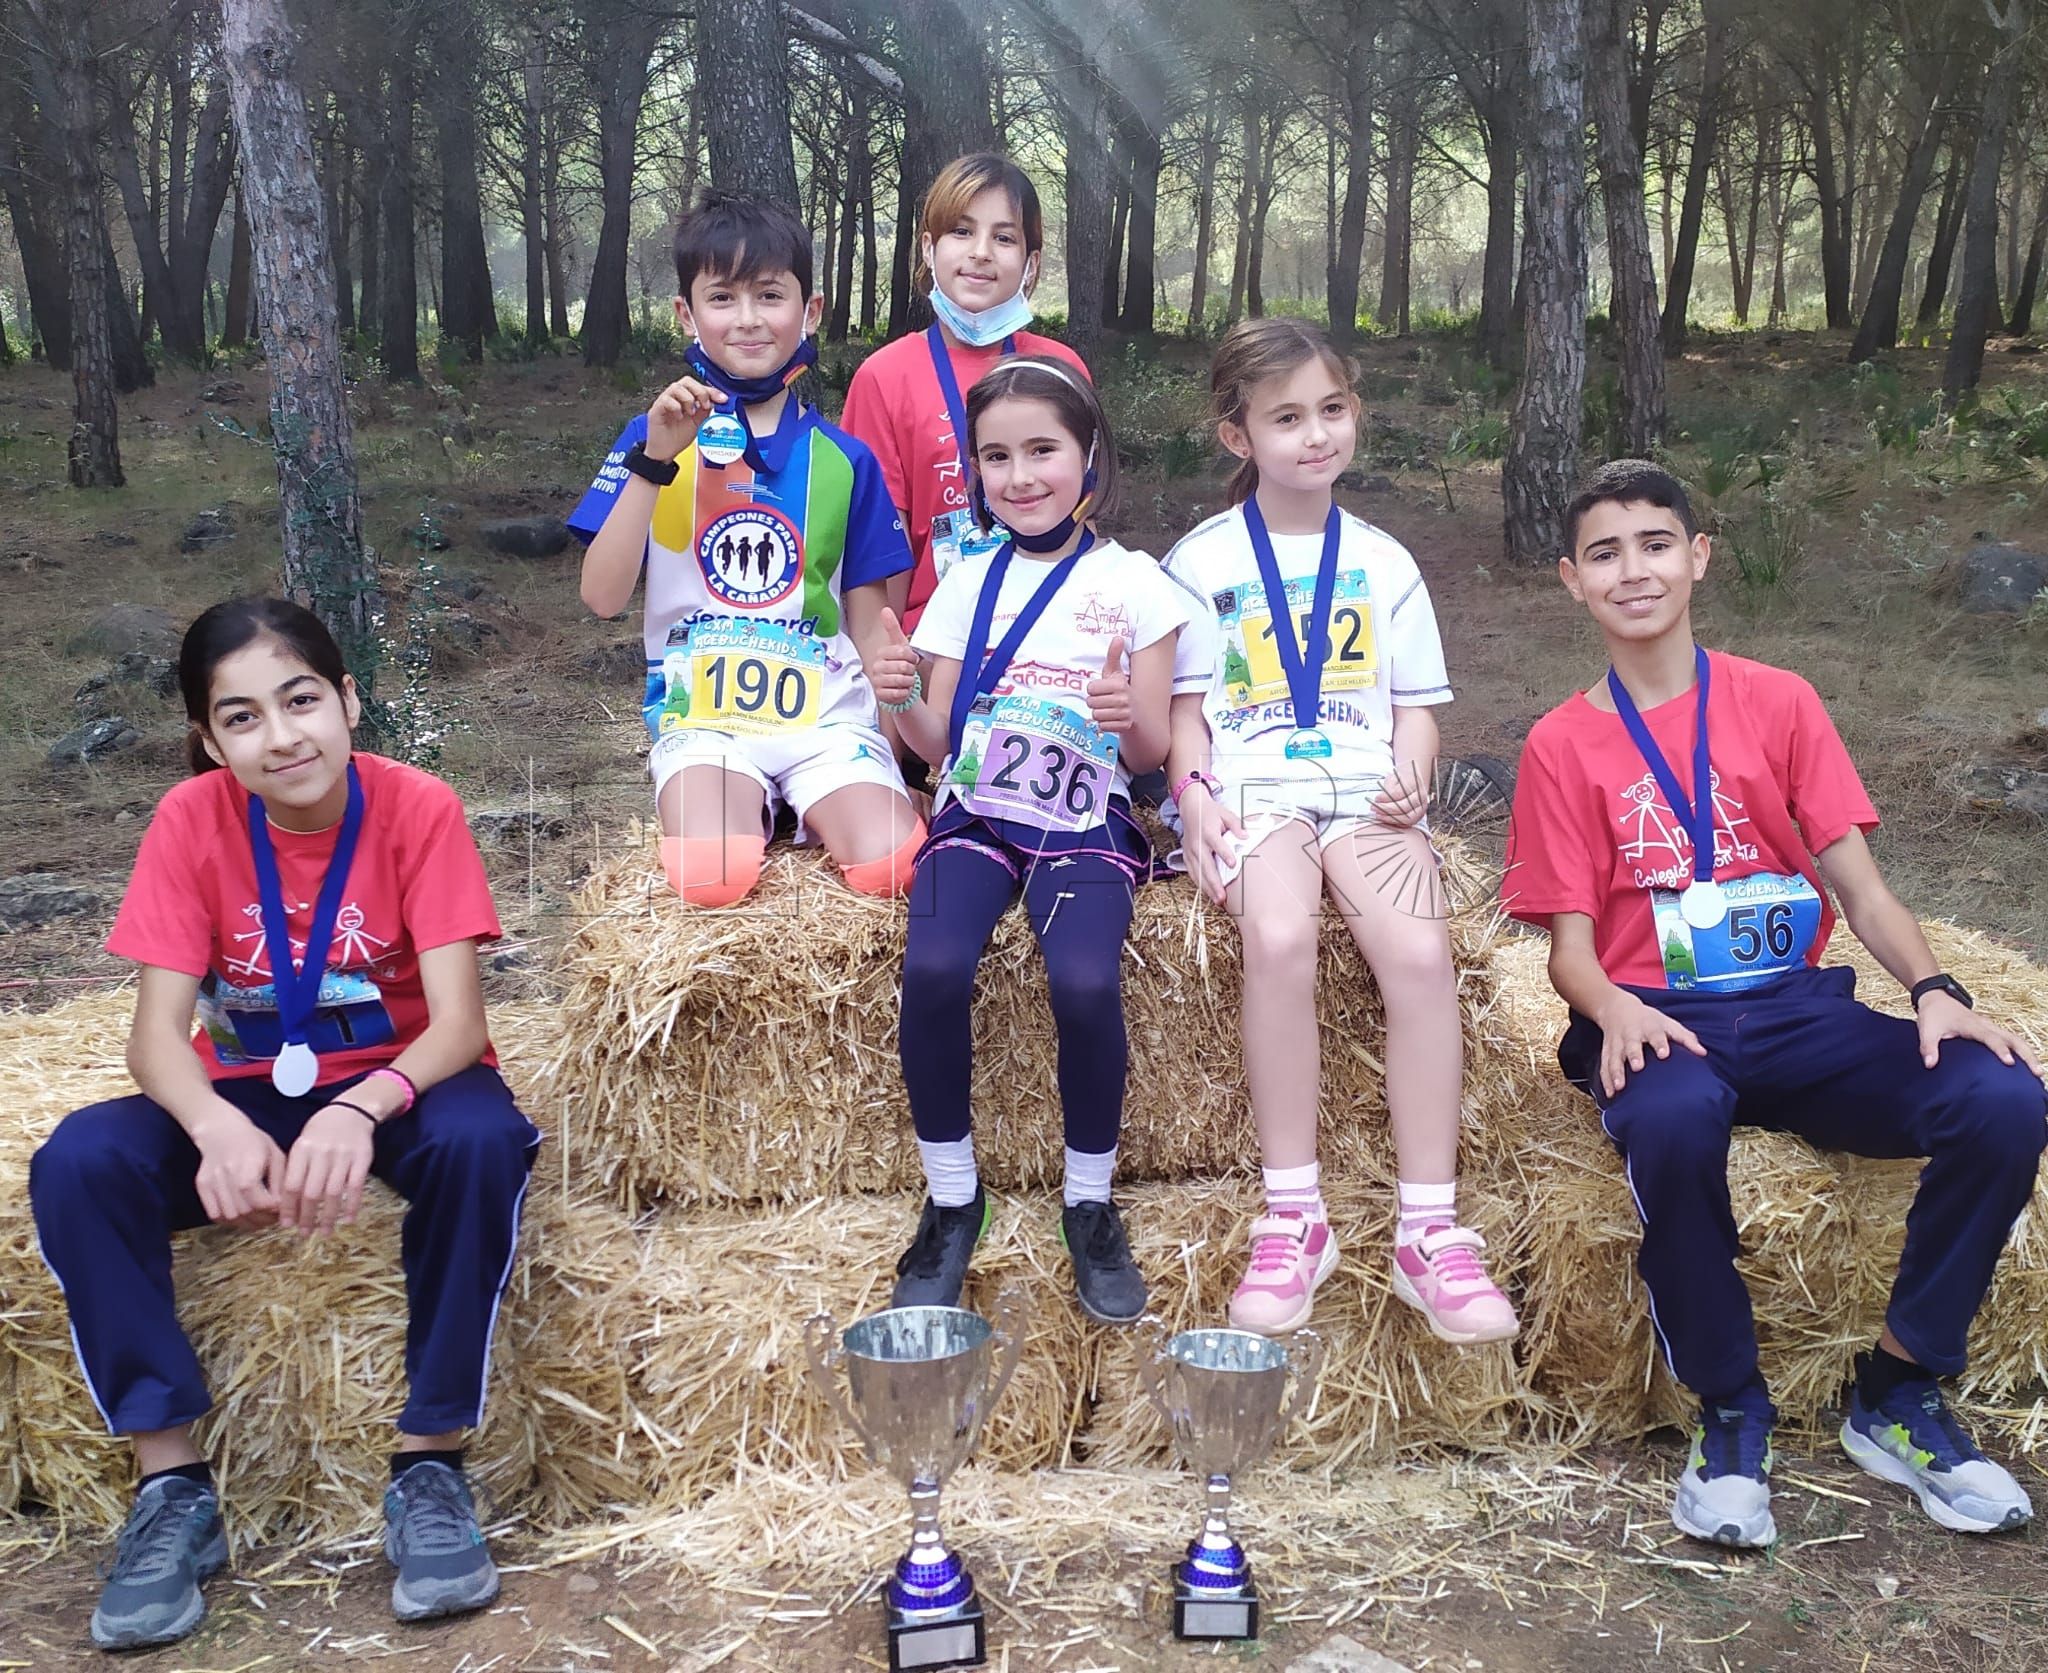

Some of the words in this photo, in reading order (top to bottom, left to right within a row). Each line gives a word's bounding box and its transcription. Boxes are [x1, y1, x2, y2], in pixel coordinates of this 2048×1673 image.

[700, 512, 775, 558] CAMPEONES
[775, 523, 797, 564] PARA
[708, 574, 724, 593] LA
[727, 580, 788, 604] CAÑADA
[694, 635, 798, 658] ACEBUCHEKIDS
[704, 655, 808, 719] 190
[996, 708, 1093, 752] ACEBUCHEKIDS
[1263, 699, 1370, 730] ACECHEKIDS
[990, 733, 1099, 817] 236
[1635, 865, 1690, 889] Colegio
[1729, 903, 1795, 964] 56
